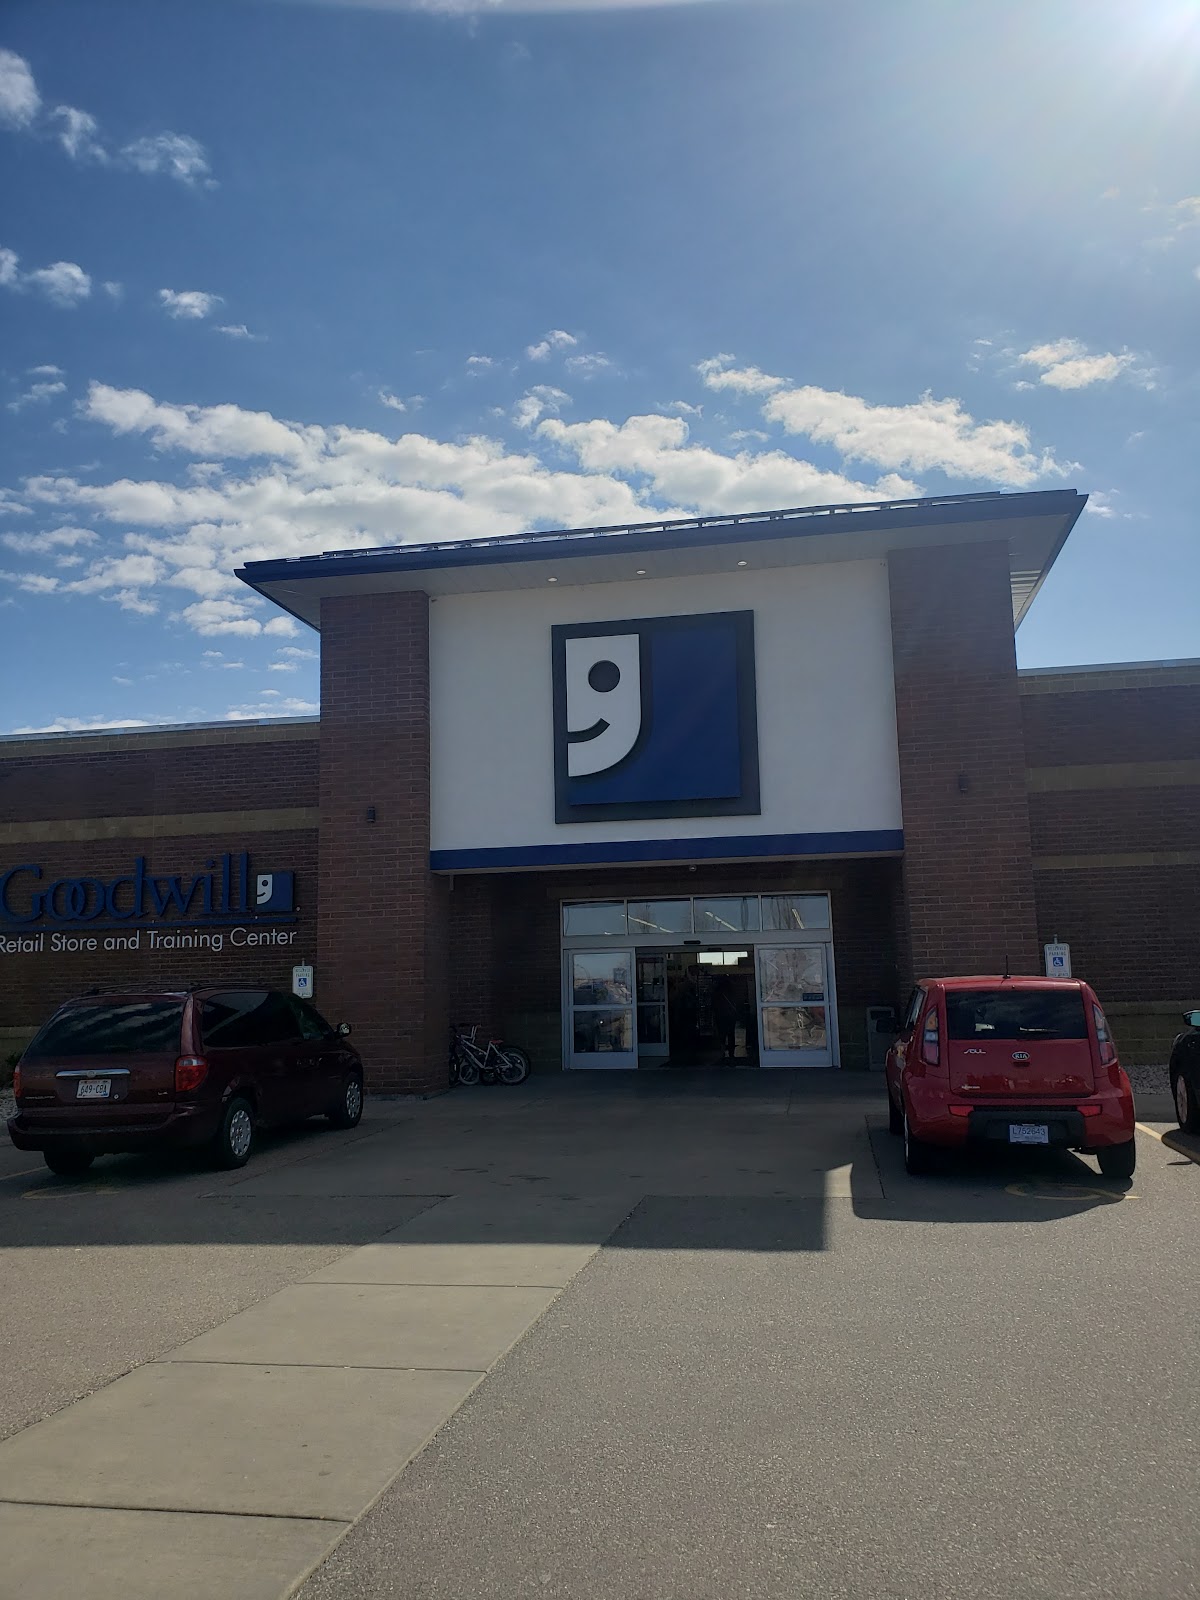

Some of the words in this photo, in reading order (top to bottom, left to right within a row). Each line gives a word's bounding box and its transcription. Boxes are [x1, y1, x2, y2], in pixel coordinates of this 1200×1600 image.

[0, 852, 249, 923] Goodwill
[0, 933, 44, 953] Retail
[50, 932, 98, 951] Store
[103, 930, 140, 949] and
[147, 929, 223, 951] Training
[230, 927, 297, 946] Center
